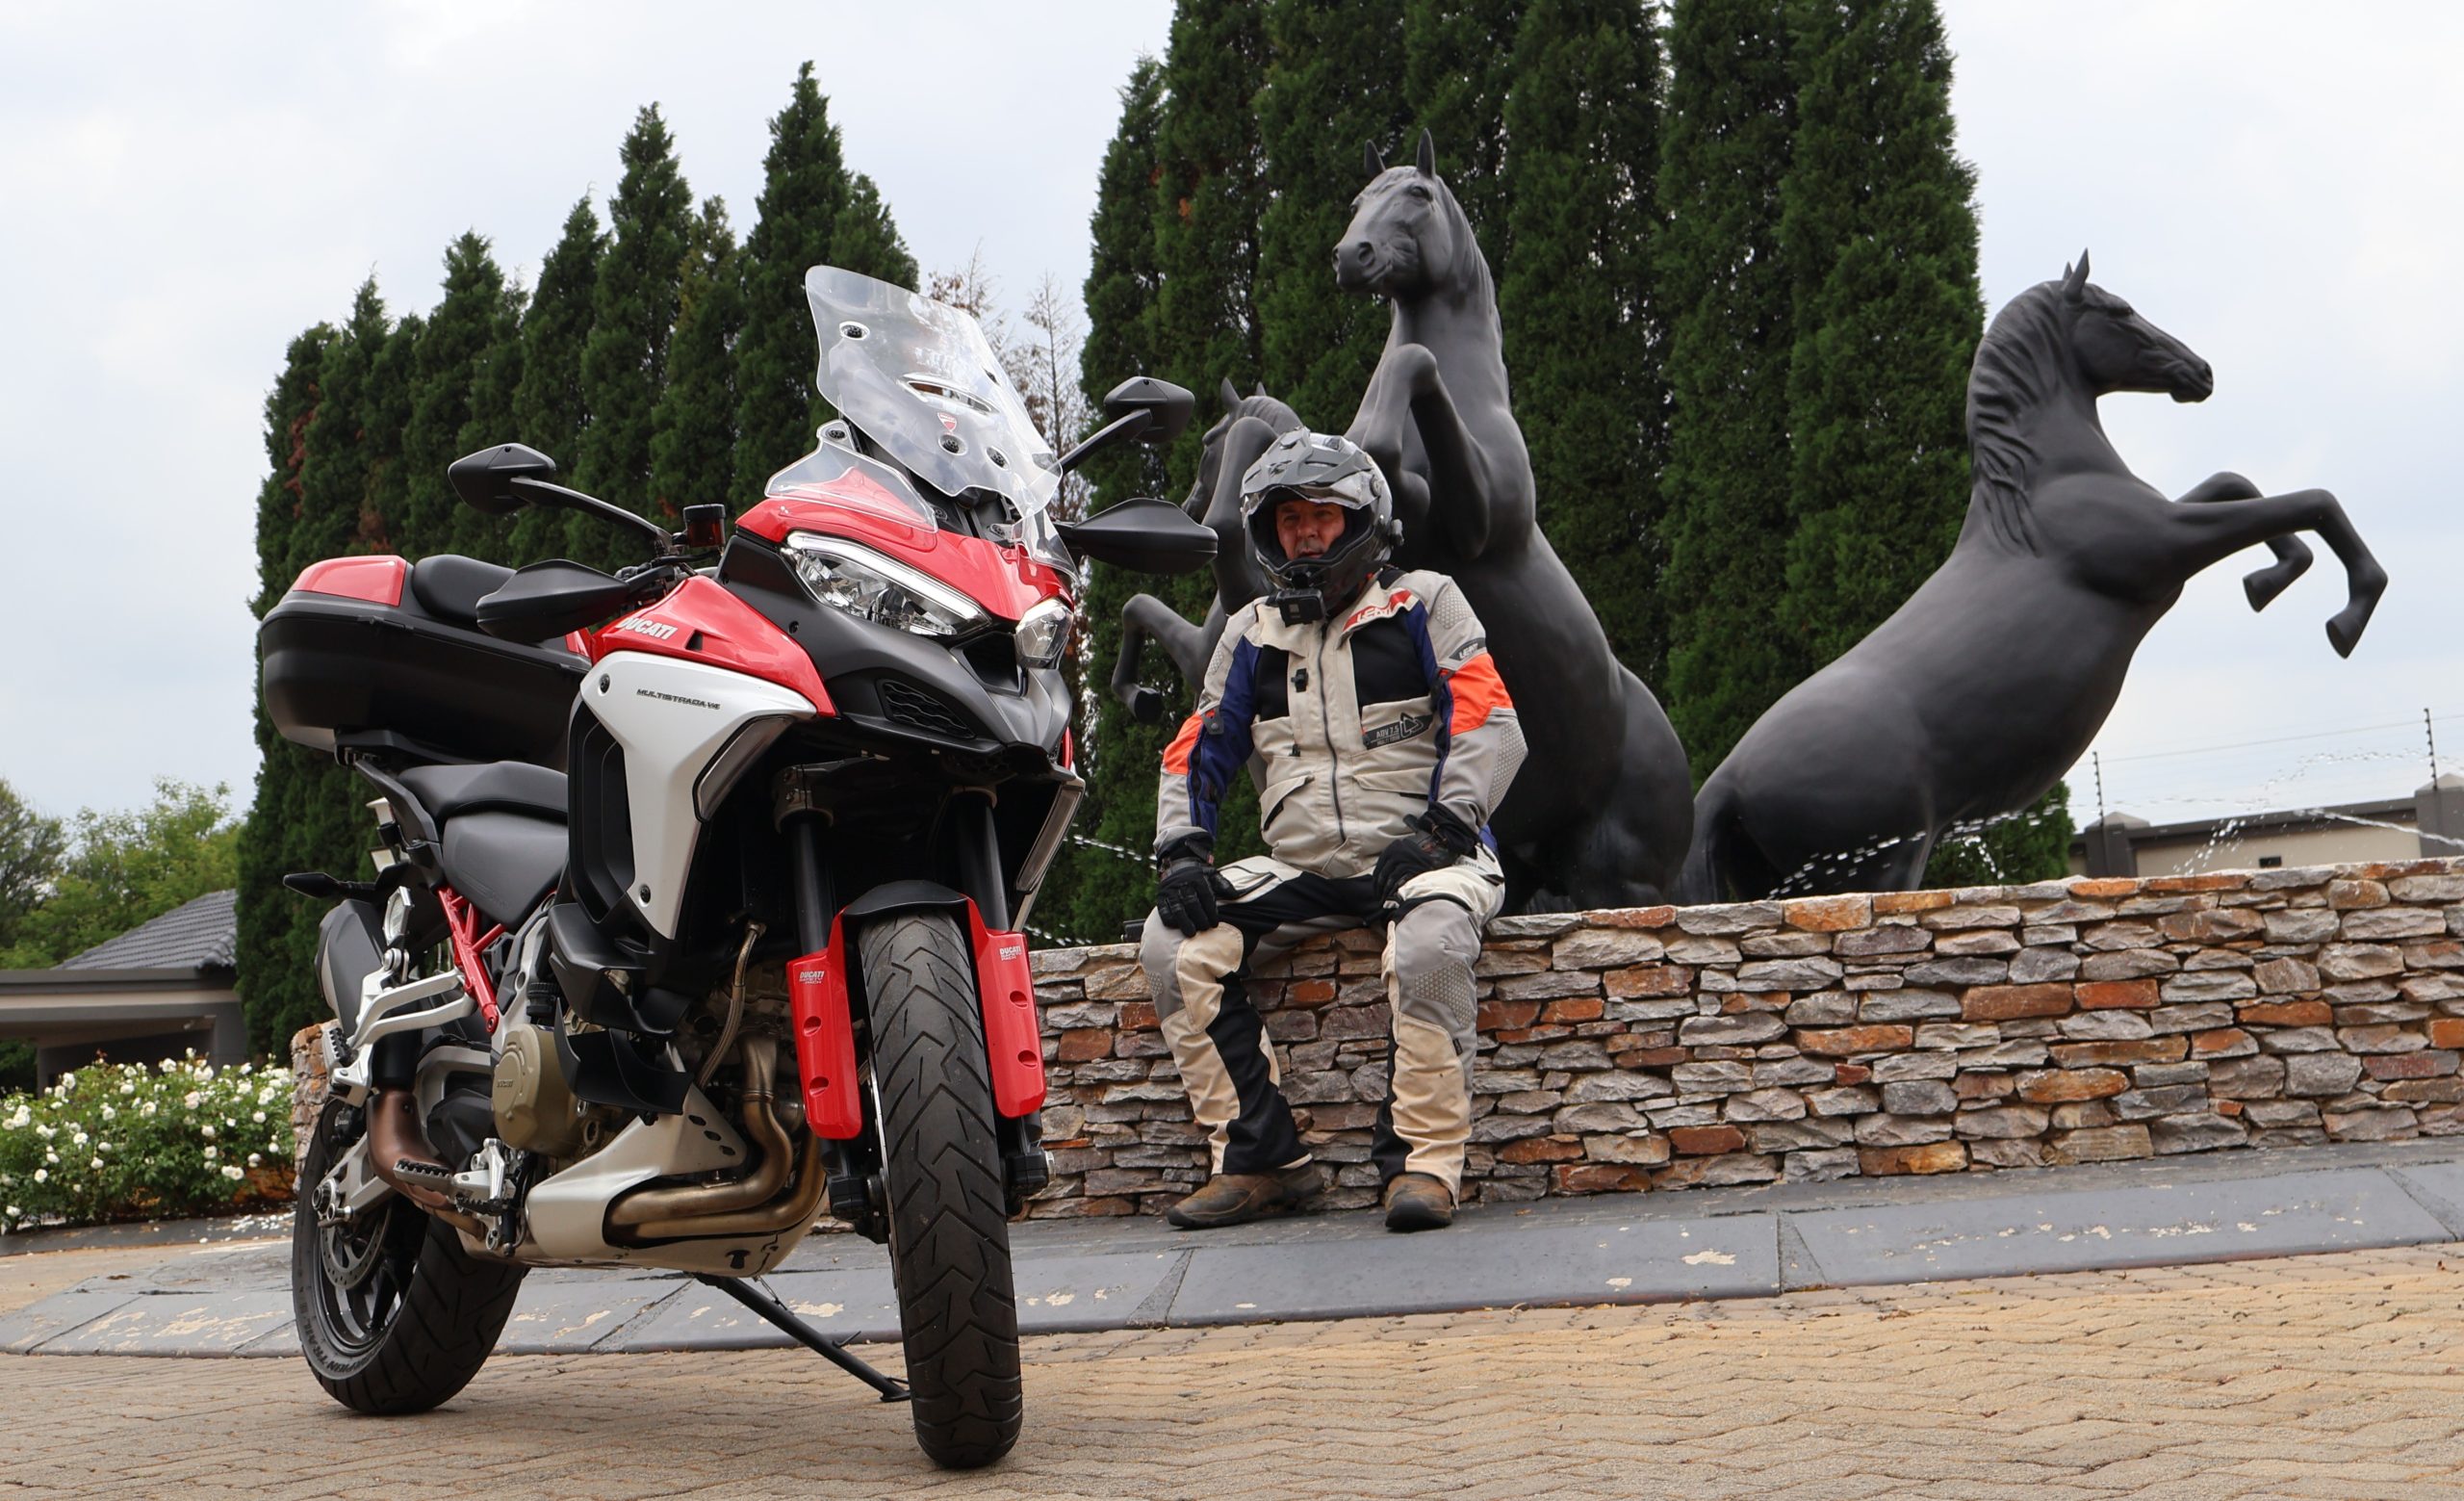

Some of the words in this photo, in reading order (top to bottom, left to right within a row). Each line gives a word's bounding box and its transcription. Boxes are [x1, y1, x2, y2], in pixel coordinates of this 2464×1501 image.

[615, 617, 679, 640] DUCATI
[636, 688, 706, 706] MULTISTRADA
[999, 945, 1021, 955] DUCATI
[800, 970, 825, 979] DUCATI
